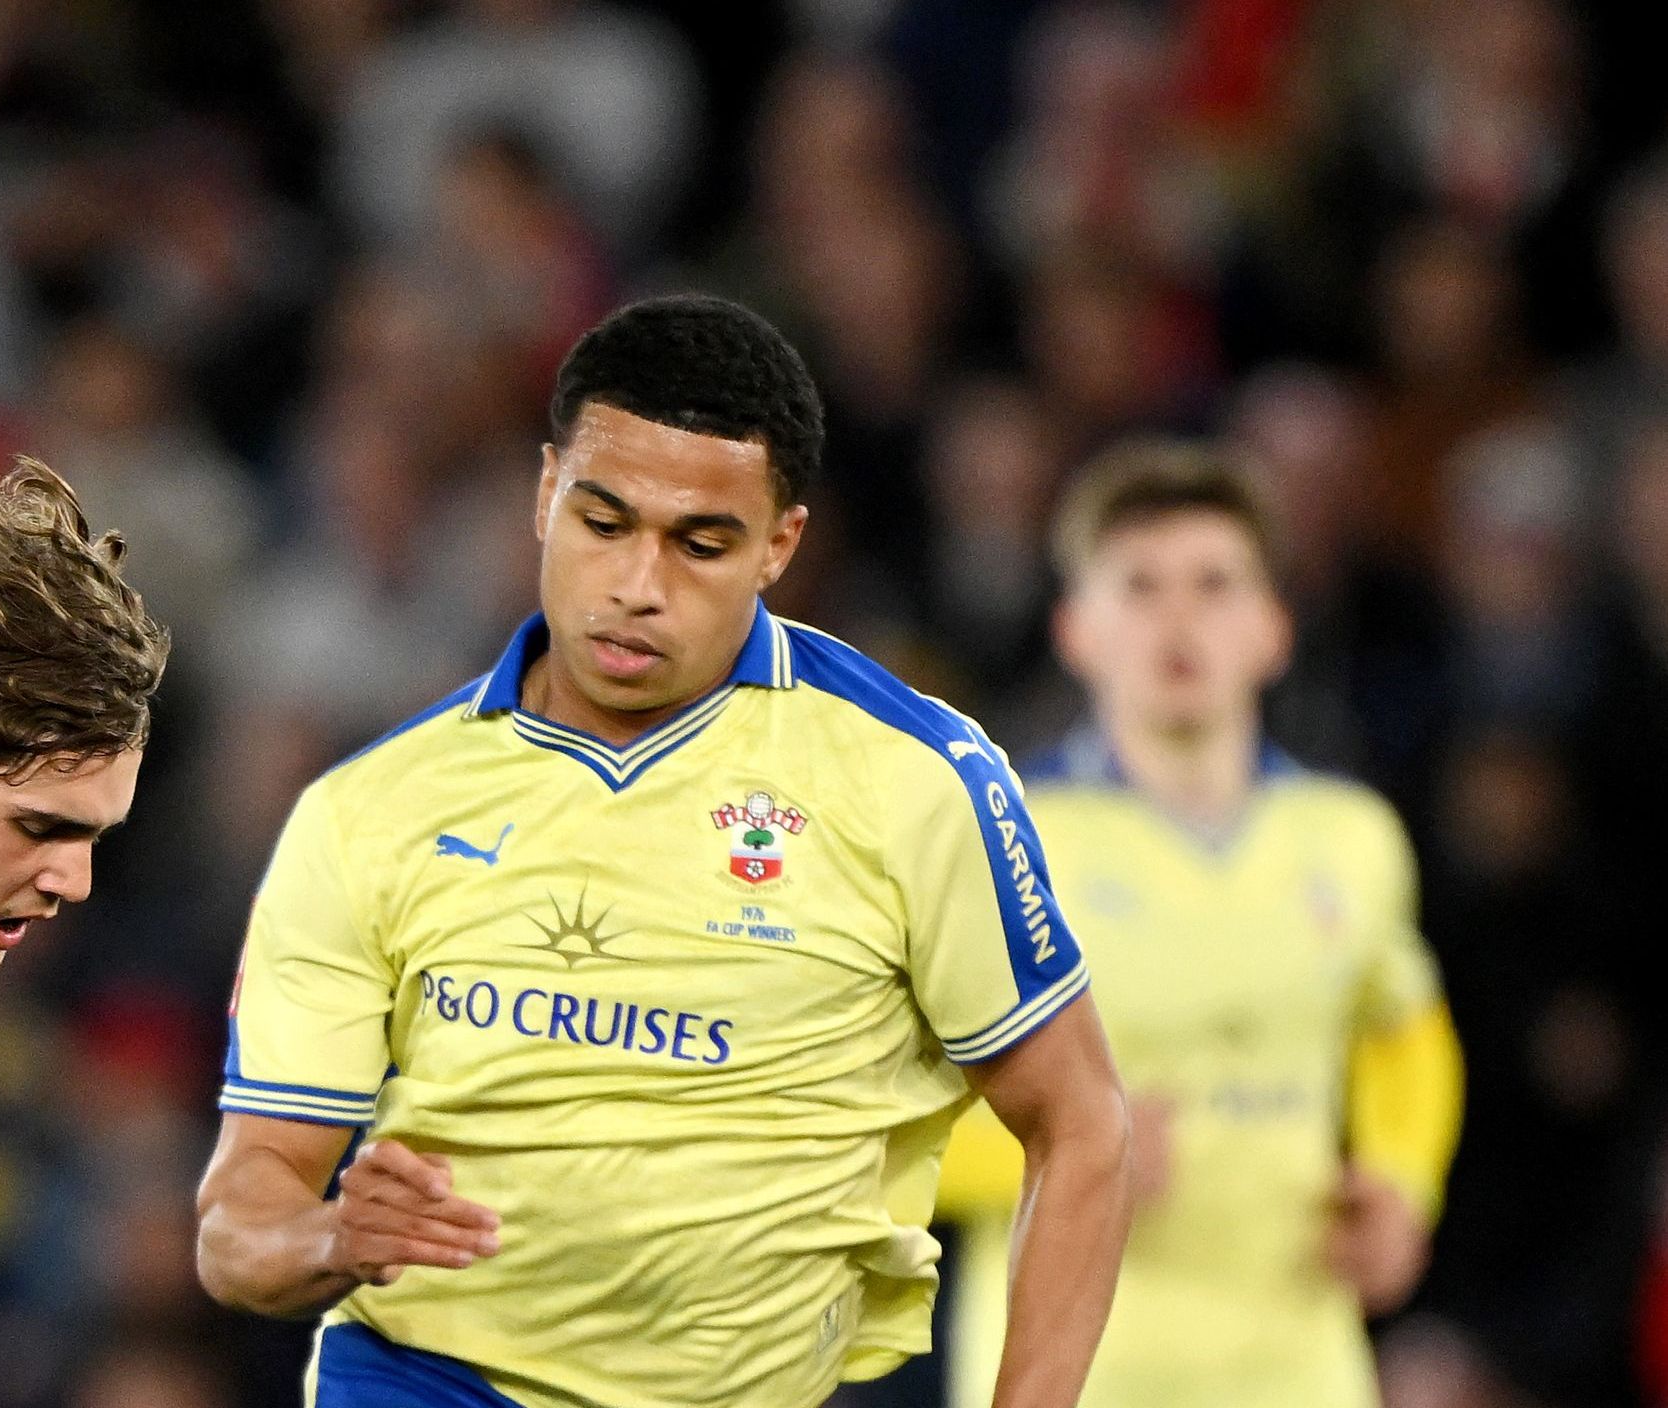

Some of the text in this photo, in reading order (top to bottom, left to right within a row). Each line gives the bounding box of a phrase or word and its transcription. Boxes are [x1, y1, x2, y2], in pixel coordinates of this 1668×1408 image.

[987, 781, 1057, 965] GARMIN
[722, 922, 744, 936] CUP
[420, 969, 733, 1065] P&O CRUISES
